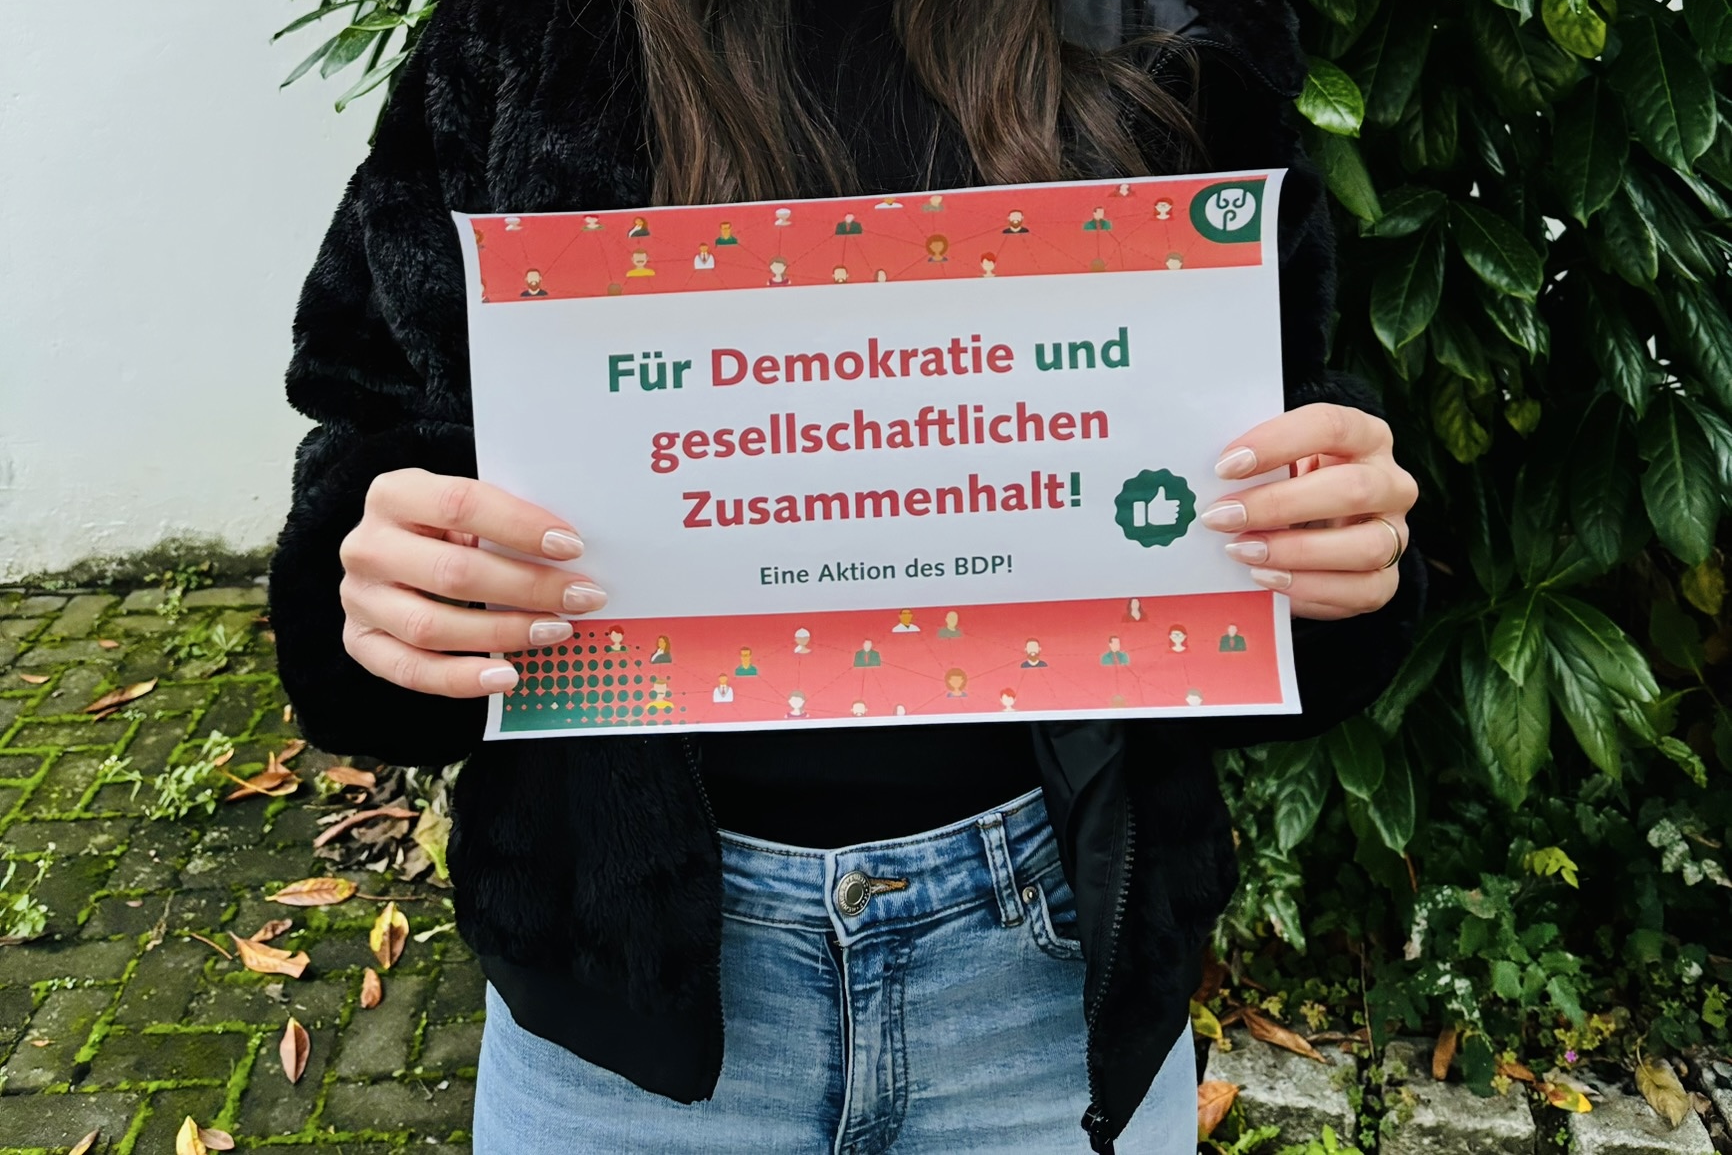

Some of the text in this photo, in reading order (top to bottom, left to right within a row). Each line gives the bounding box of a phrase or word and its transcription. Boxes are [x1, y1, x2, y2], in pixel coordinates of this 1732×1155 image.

[608, 326, 1131, 393] Für Demokratie und
[650, 401, 1109, 474] gesellschaftlichen
[682, 470, 1082, 529] Zusammenhalt!
[760, 554, 1014, 586] Eine Aktion des BDP!
